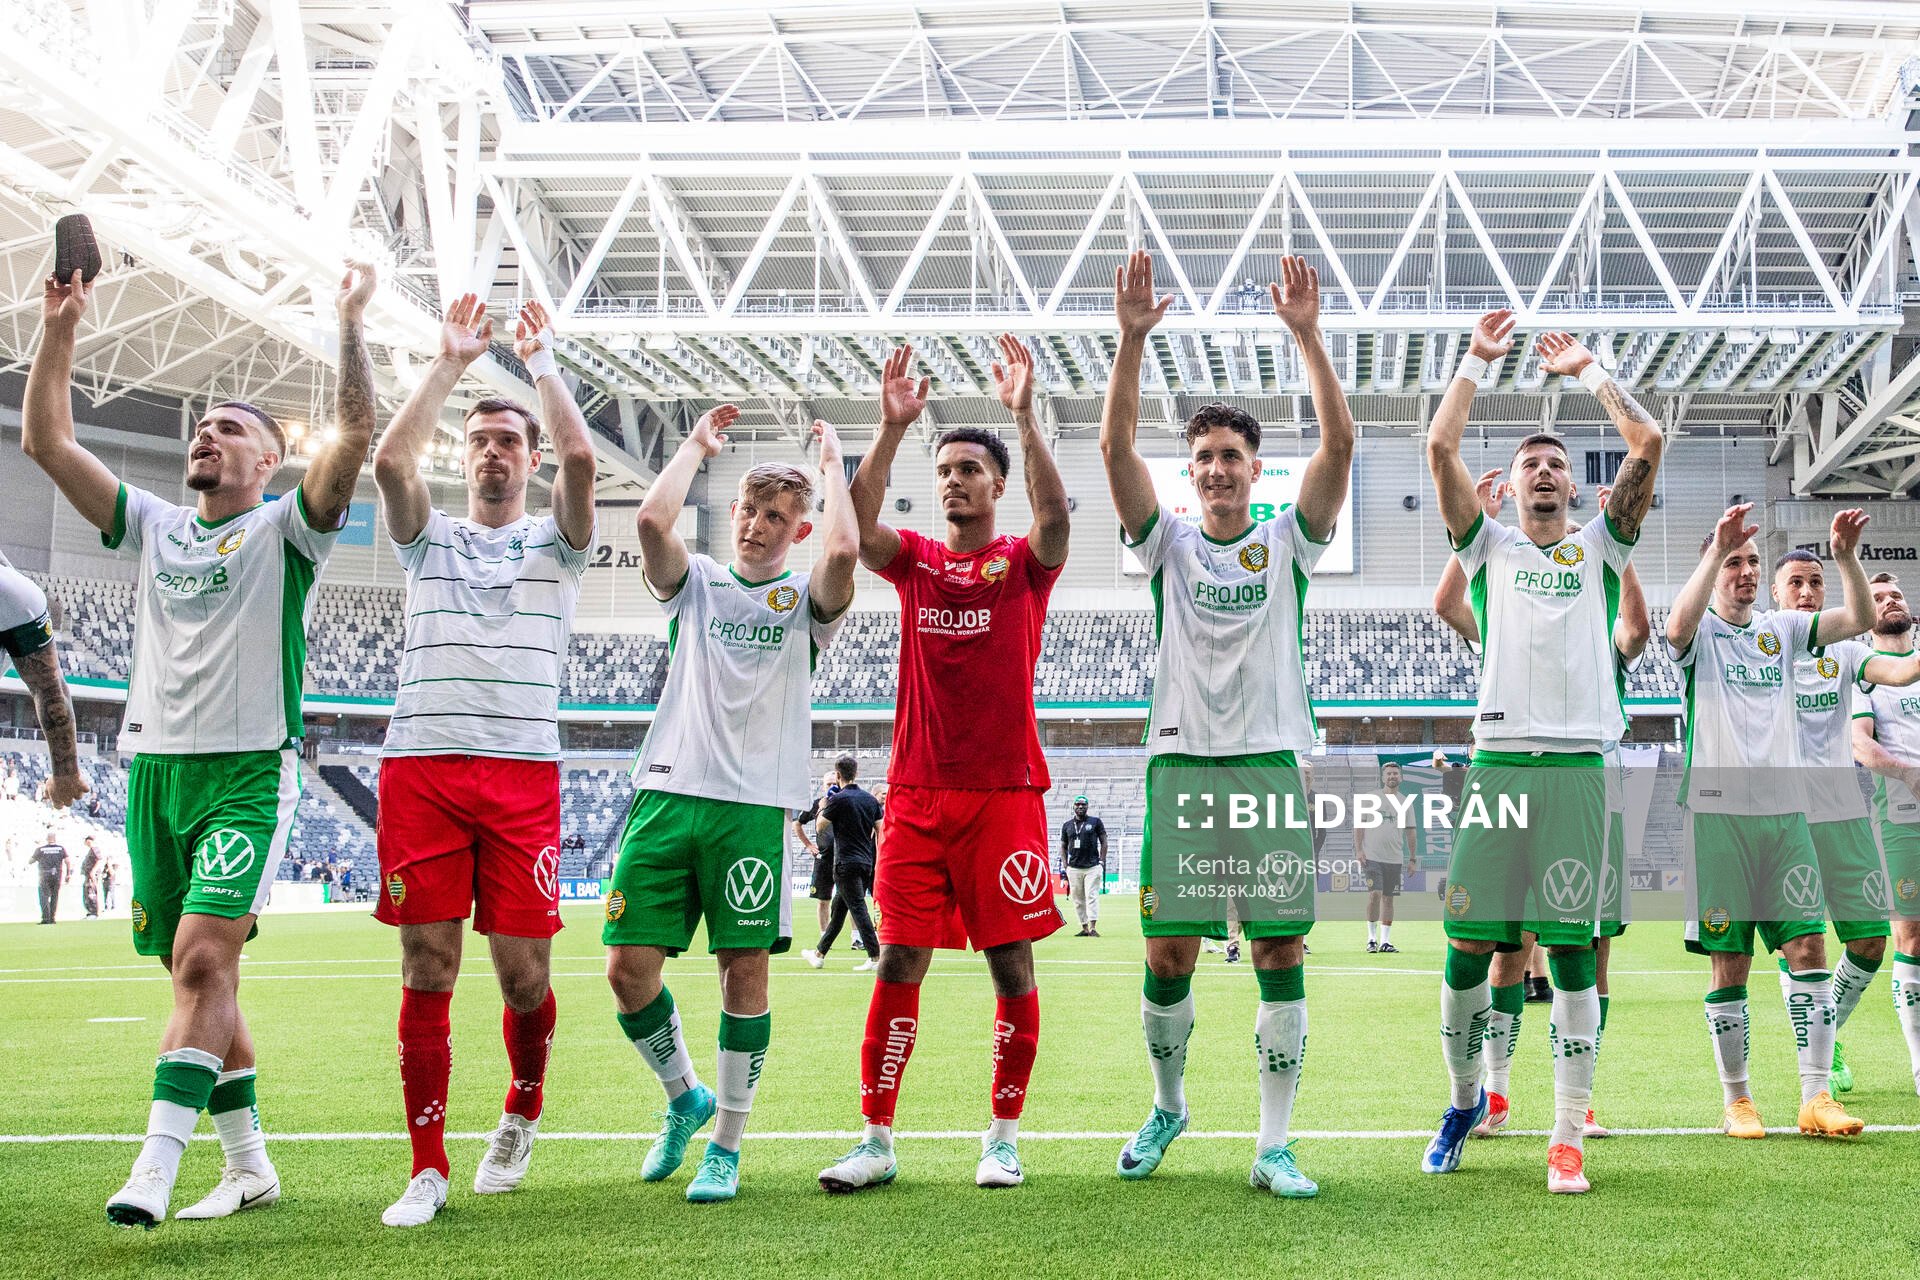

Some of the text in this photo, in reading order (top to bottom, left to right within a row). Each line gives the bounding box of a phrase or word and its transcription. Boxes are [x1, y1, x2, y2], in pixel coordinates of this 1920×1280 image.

[1859, 544, 1918, 561] Arena
[1195, 581, 1268, 604] PROJOB
[918, 607, 991, 629] PROJOB
[709, 616, 784, 644] PROJOB
[917, 626, 956, 636] PROFESSIONAL
[1796, 691, 1839, 709] ROJOB
[202, 886, 234, 895] CRAFT
[576, 881, 600, 897] BAR
[1022, 909, 1048, 920] CRAFT
[1559, 917, 1585, 925] CRAFT
